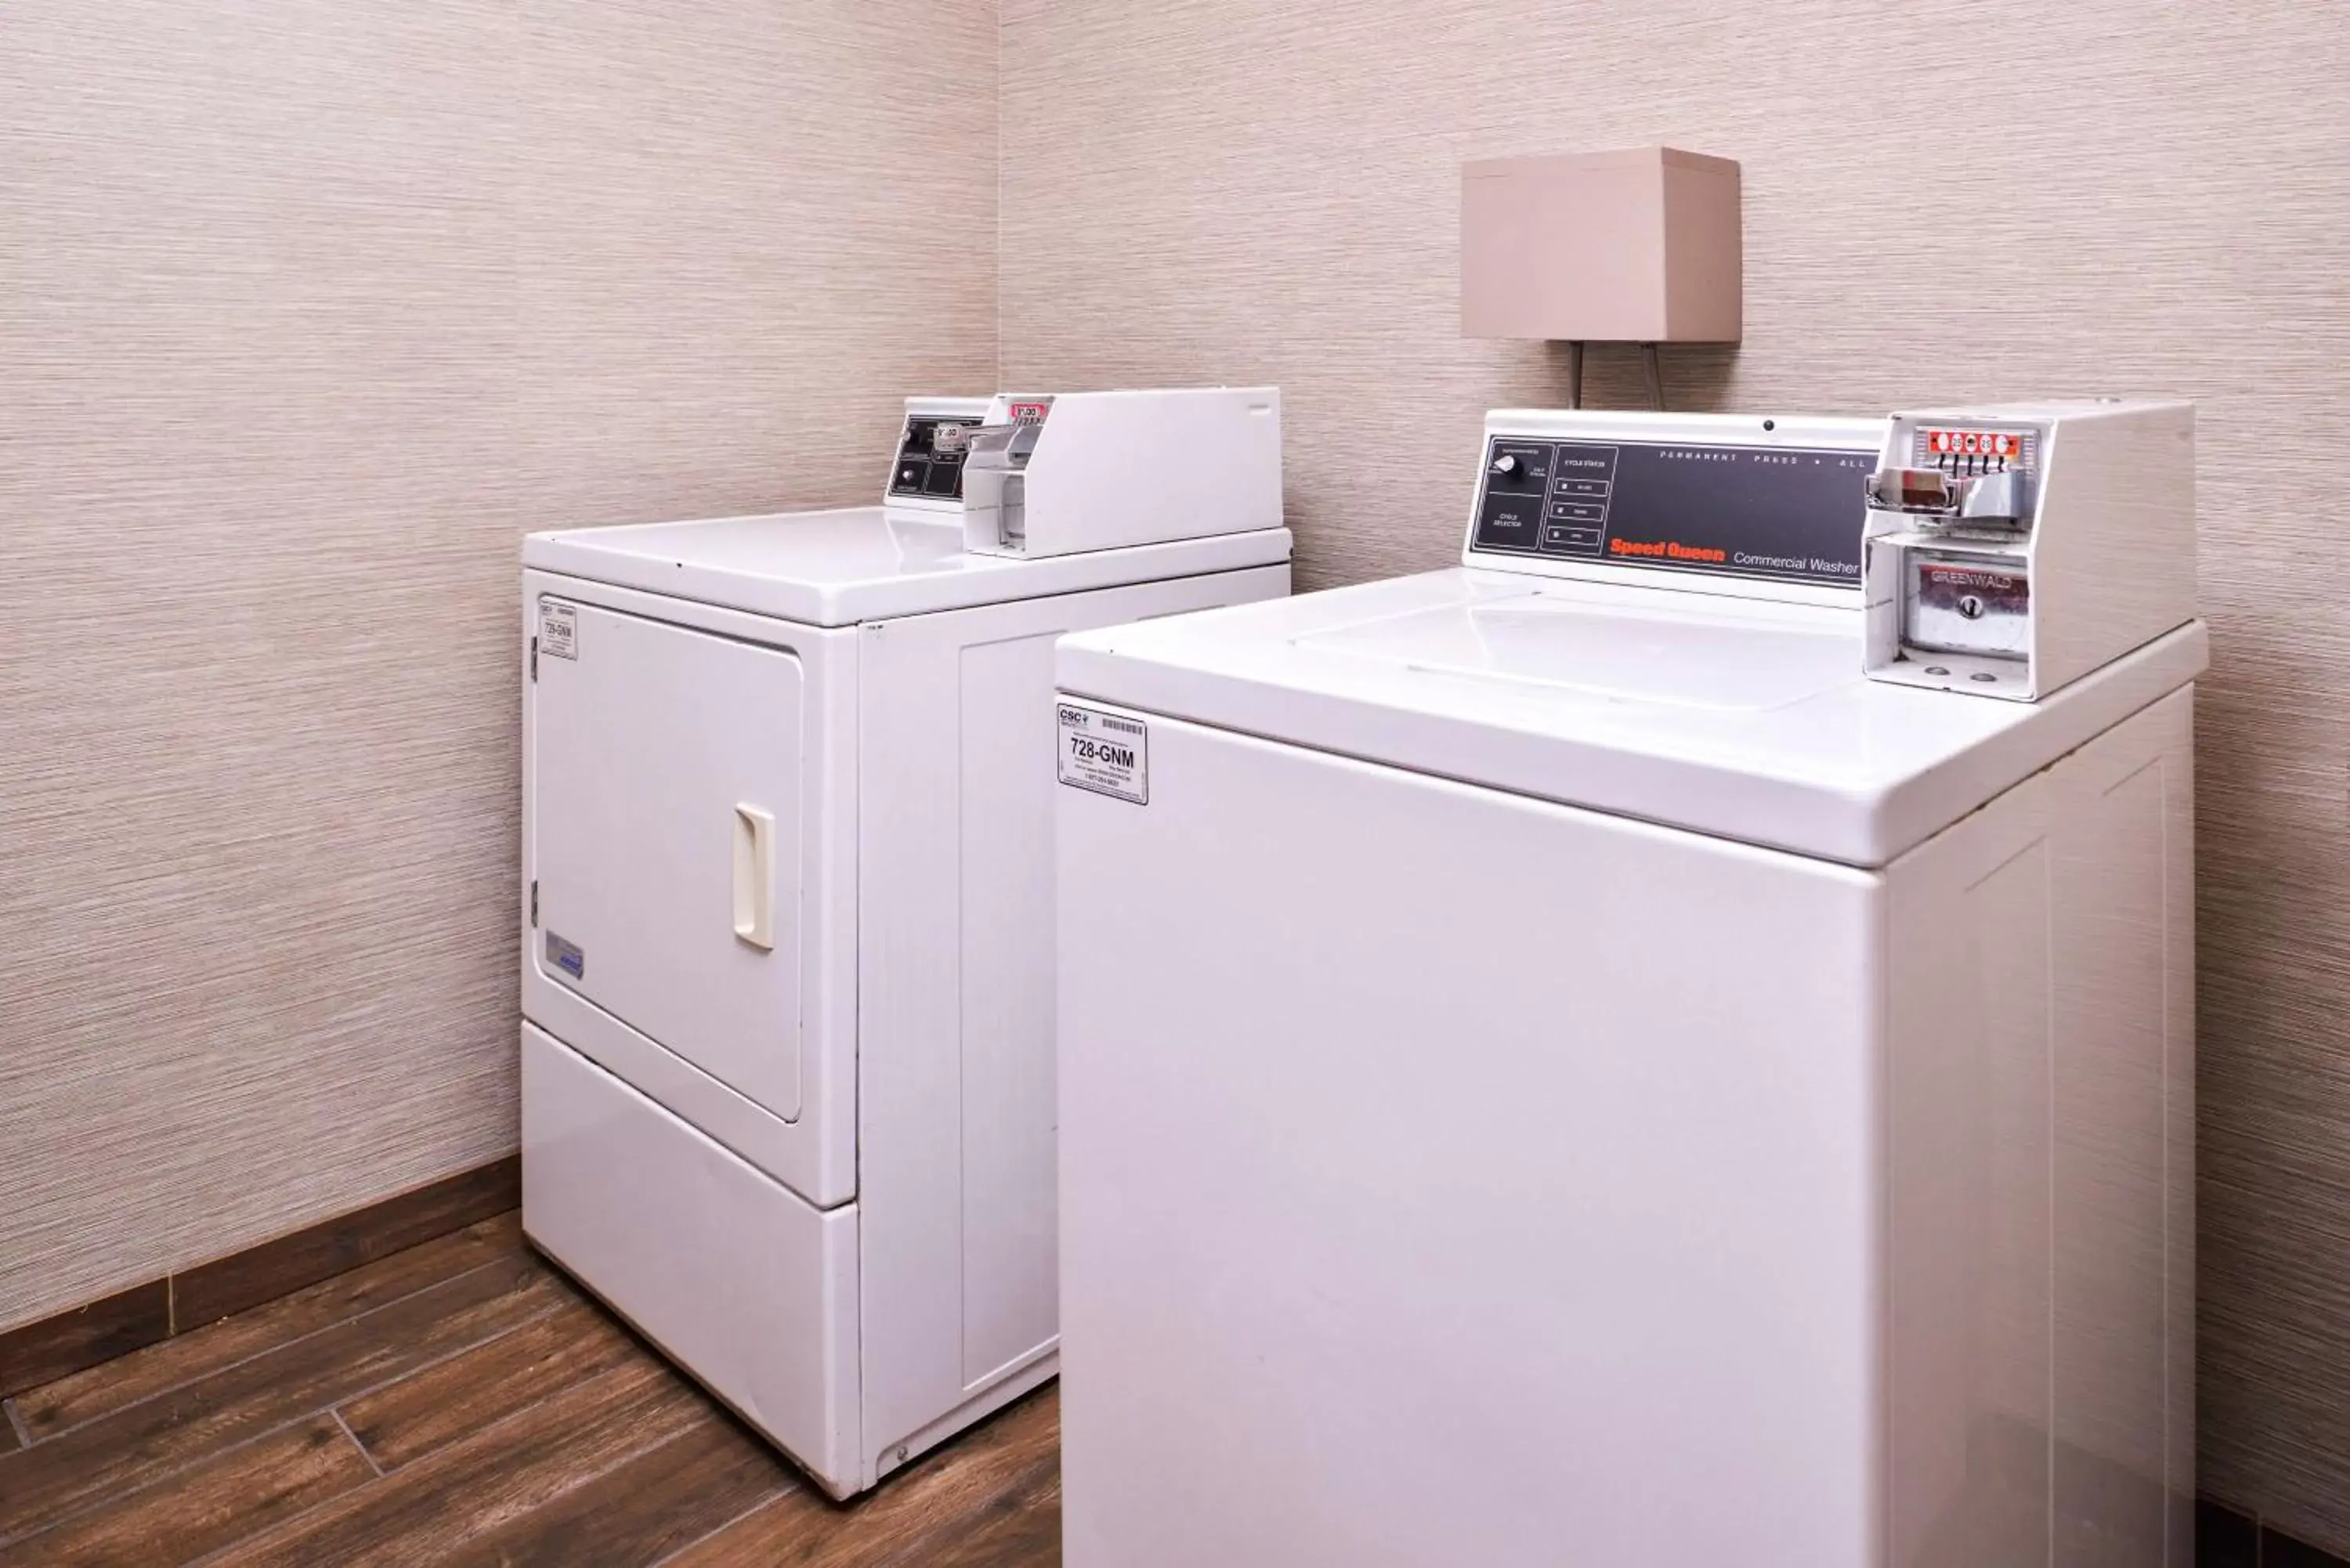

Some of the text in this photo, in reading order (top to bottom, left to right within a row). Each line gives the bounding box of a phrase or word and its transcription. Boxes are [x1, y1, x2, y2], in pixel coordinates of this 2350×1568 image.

[1660, 450, 1737, 462] PERMANENT
[1754, 455, 1798, 464] PRESS
[1610, 537, 1726, 562] Speed Queen
[1734, 551, 1860, 575] Commercial Washer
[1932, 571, 2012, 589] GREENWALD
[1060, 709, 1082, 722] CSC
[1071, 737, 1134, 768] 728-GNM
